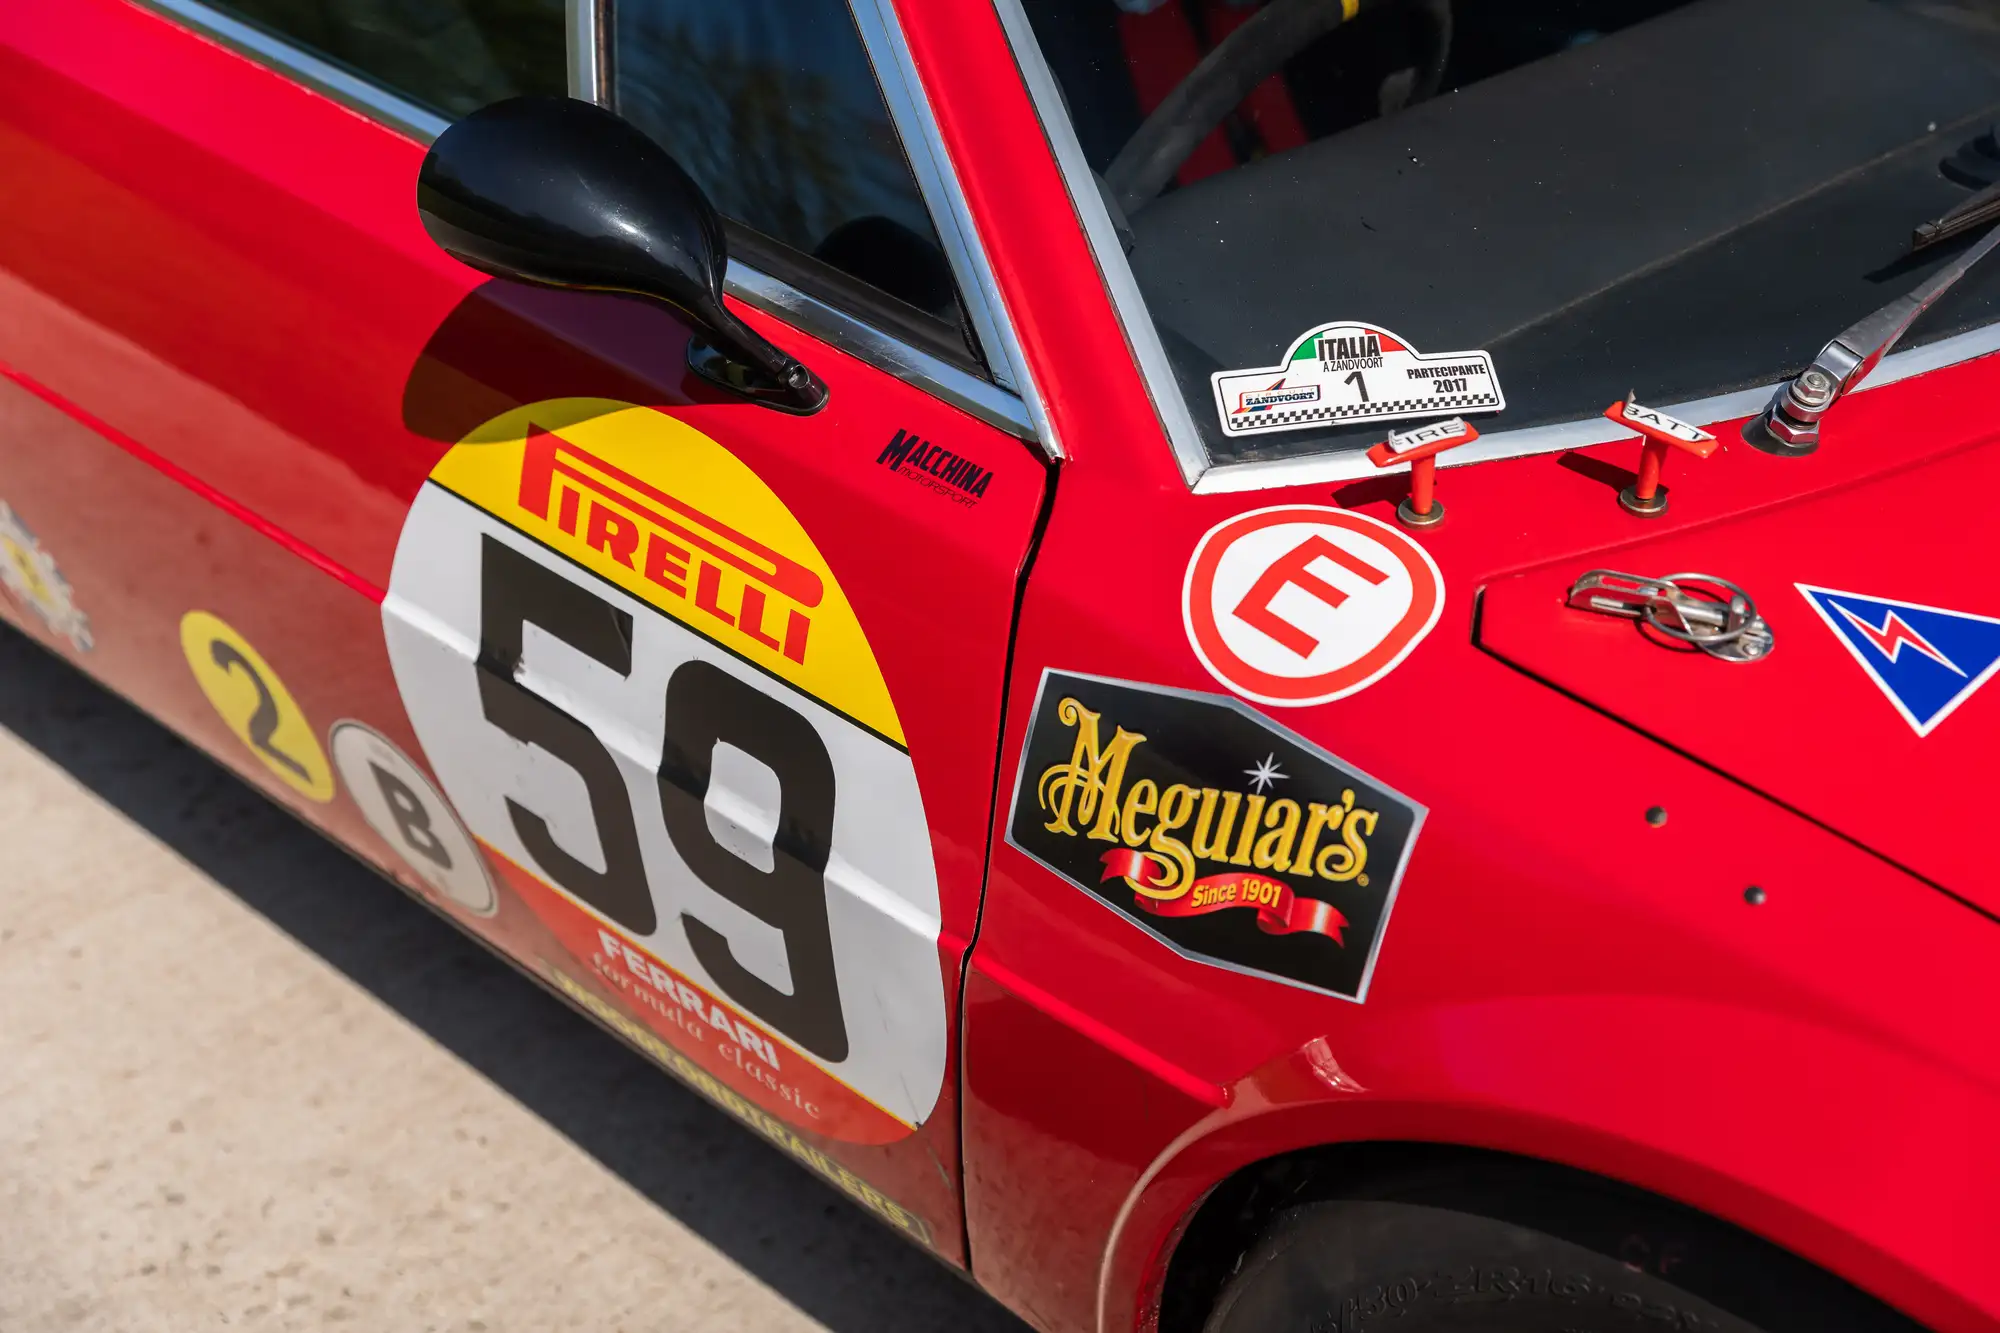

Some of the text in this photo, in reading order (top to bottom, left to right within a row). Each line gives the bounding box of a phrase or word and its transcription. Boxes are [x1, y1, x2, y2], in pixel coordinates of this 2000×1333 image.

[1318, 335, 1381, 361] ITALIA
[1323, 357, 1383, 372] A ZANDVOORT
[1406, 364, 1486, 379] PARTECIPANTE
[1245, 392, 1315, 405] ZANDVOORT
[1344, 371, 1369, 402] 1
[1433, 378, 1467, 393] 2017
[876, 428, 993, 499] MACCHINA
[897, 466, 977, 508] MOTORSPORT
[518, 422, 823, 666] PIRELLI
[1232, 534, 1390, 660] E
[209, 637, 314, 786] 2
[366, 759, 453, 870] B
[475, 533, 849, 1063] 59
[1038, 697, 1380, 900] Meguiar's
[1191, 878, 1282, 908] Since 1901
[591, 951, 821, 1119] formula classic
[598, 929, 780, 1071] FERRARI
